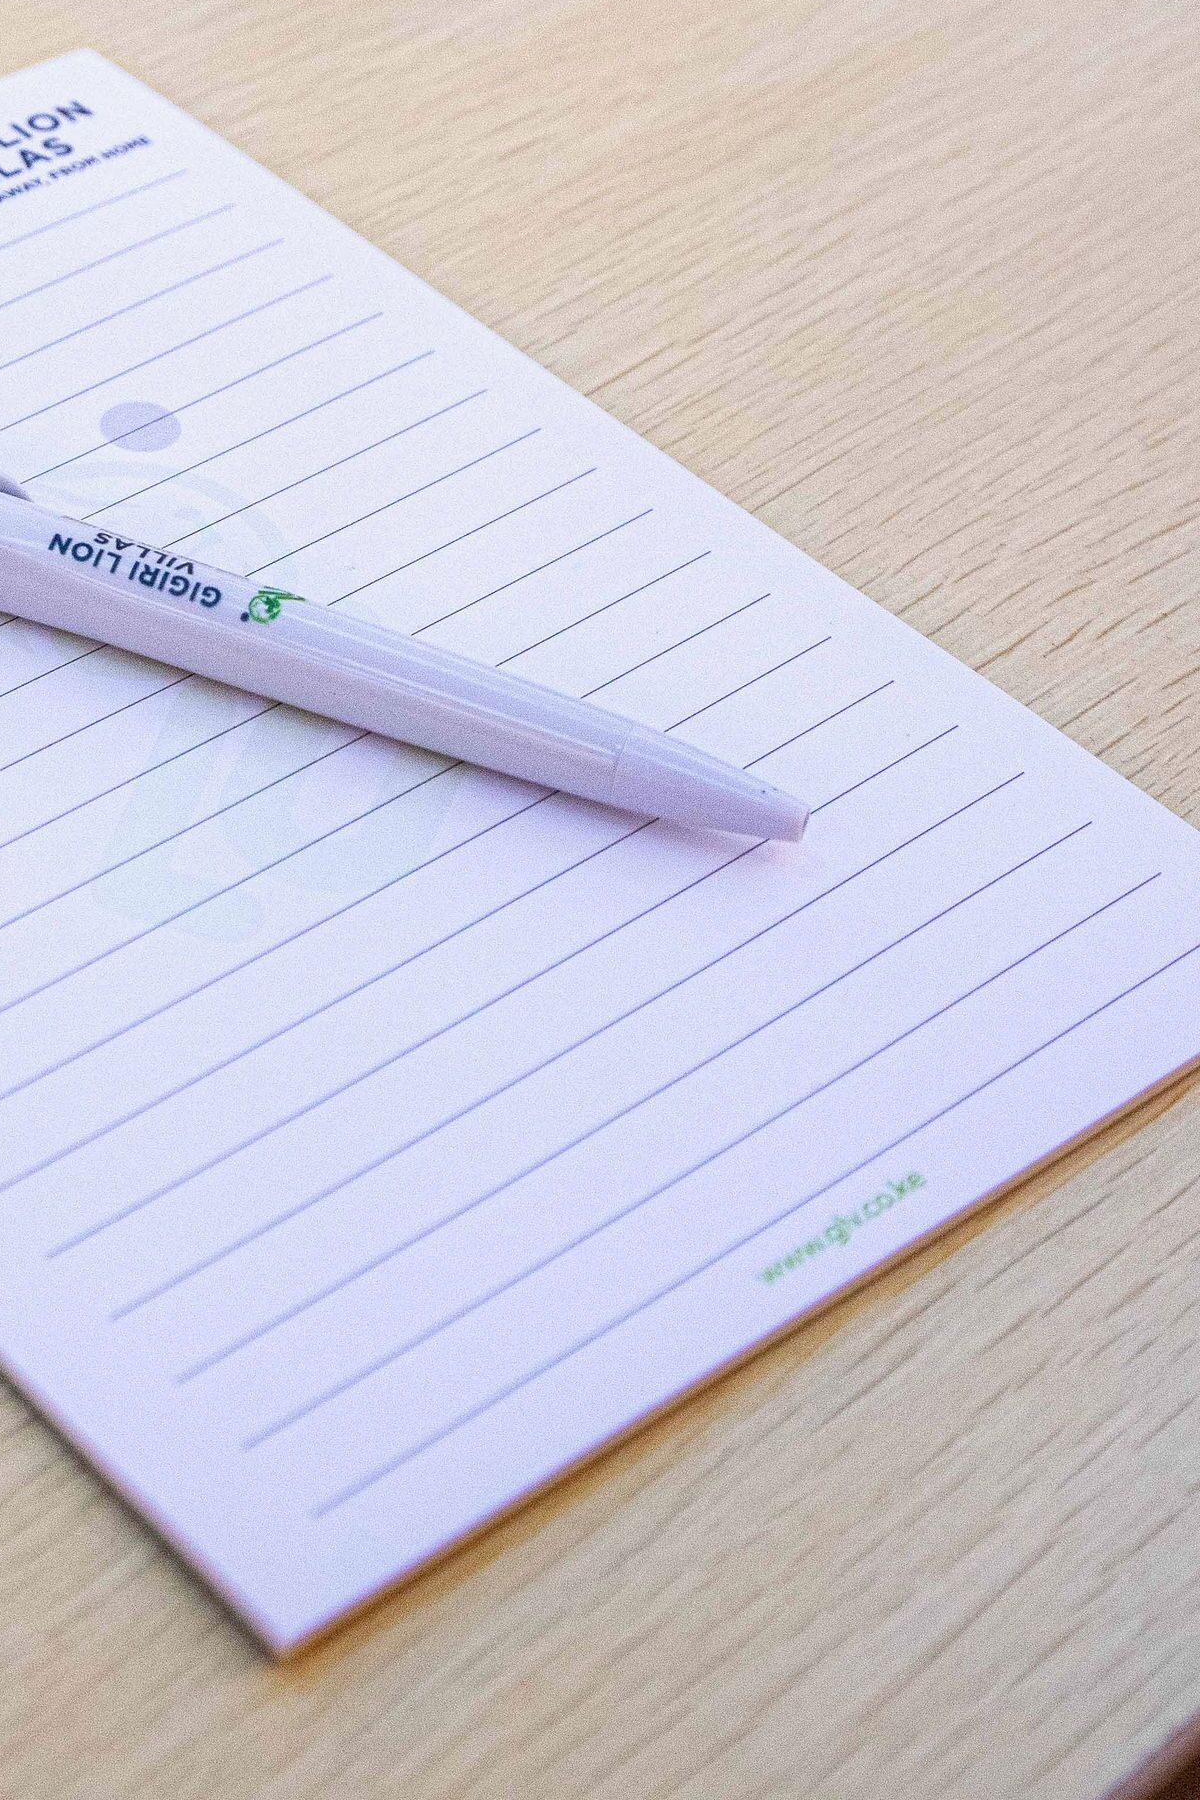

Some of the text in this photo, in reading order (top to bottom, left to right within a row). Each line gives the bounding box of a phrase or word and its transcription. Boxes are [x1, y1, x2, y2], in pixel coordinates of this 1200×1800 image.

[50, 155, 101, 180] FROM
[101, 135, 152, 160] HOME
[47, 532, 223, 609] GIGIRI LION
[92, 531, 195, 576] VILLAS
